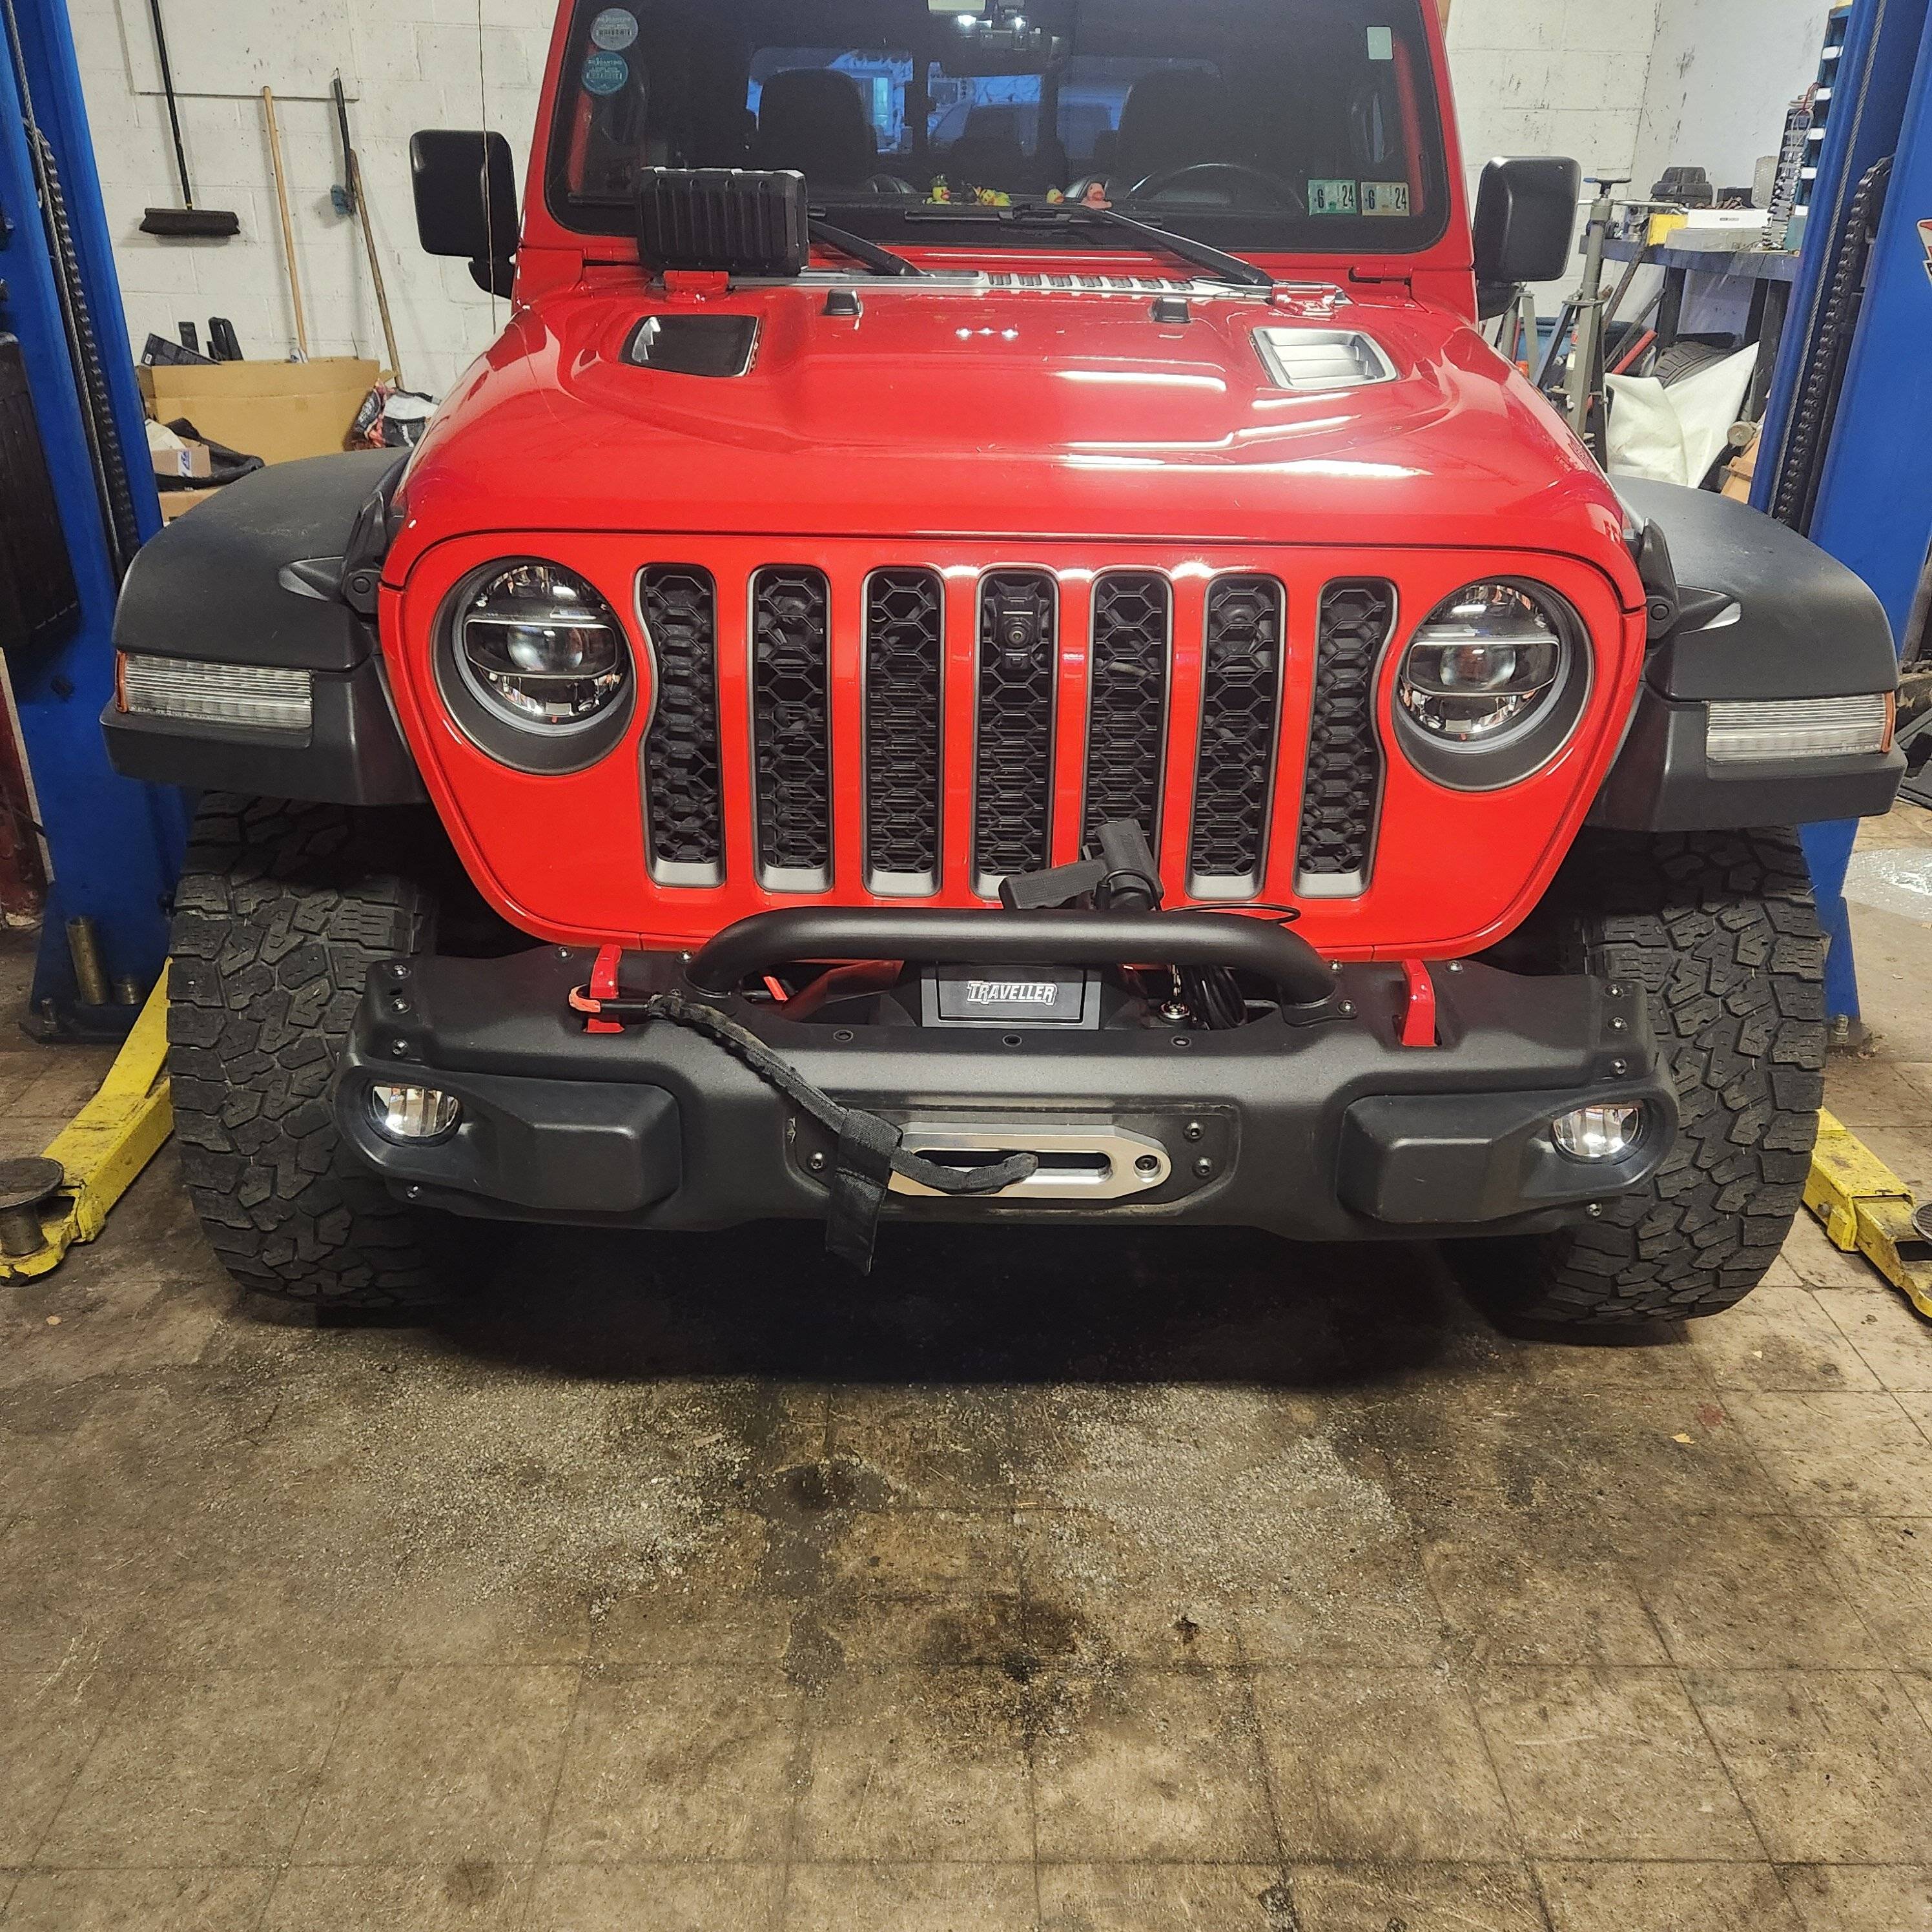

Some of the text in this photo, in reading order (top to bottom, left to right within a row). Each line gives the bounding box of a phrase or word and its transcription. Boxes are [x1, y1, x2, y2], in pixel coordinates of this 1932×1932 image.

[1317, 185, 1353, 209] 6 24
[1369, 187, 1406, 209] 6 24
[969, 982, 1056, 1004] TRAVELLER
